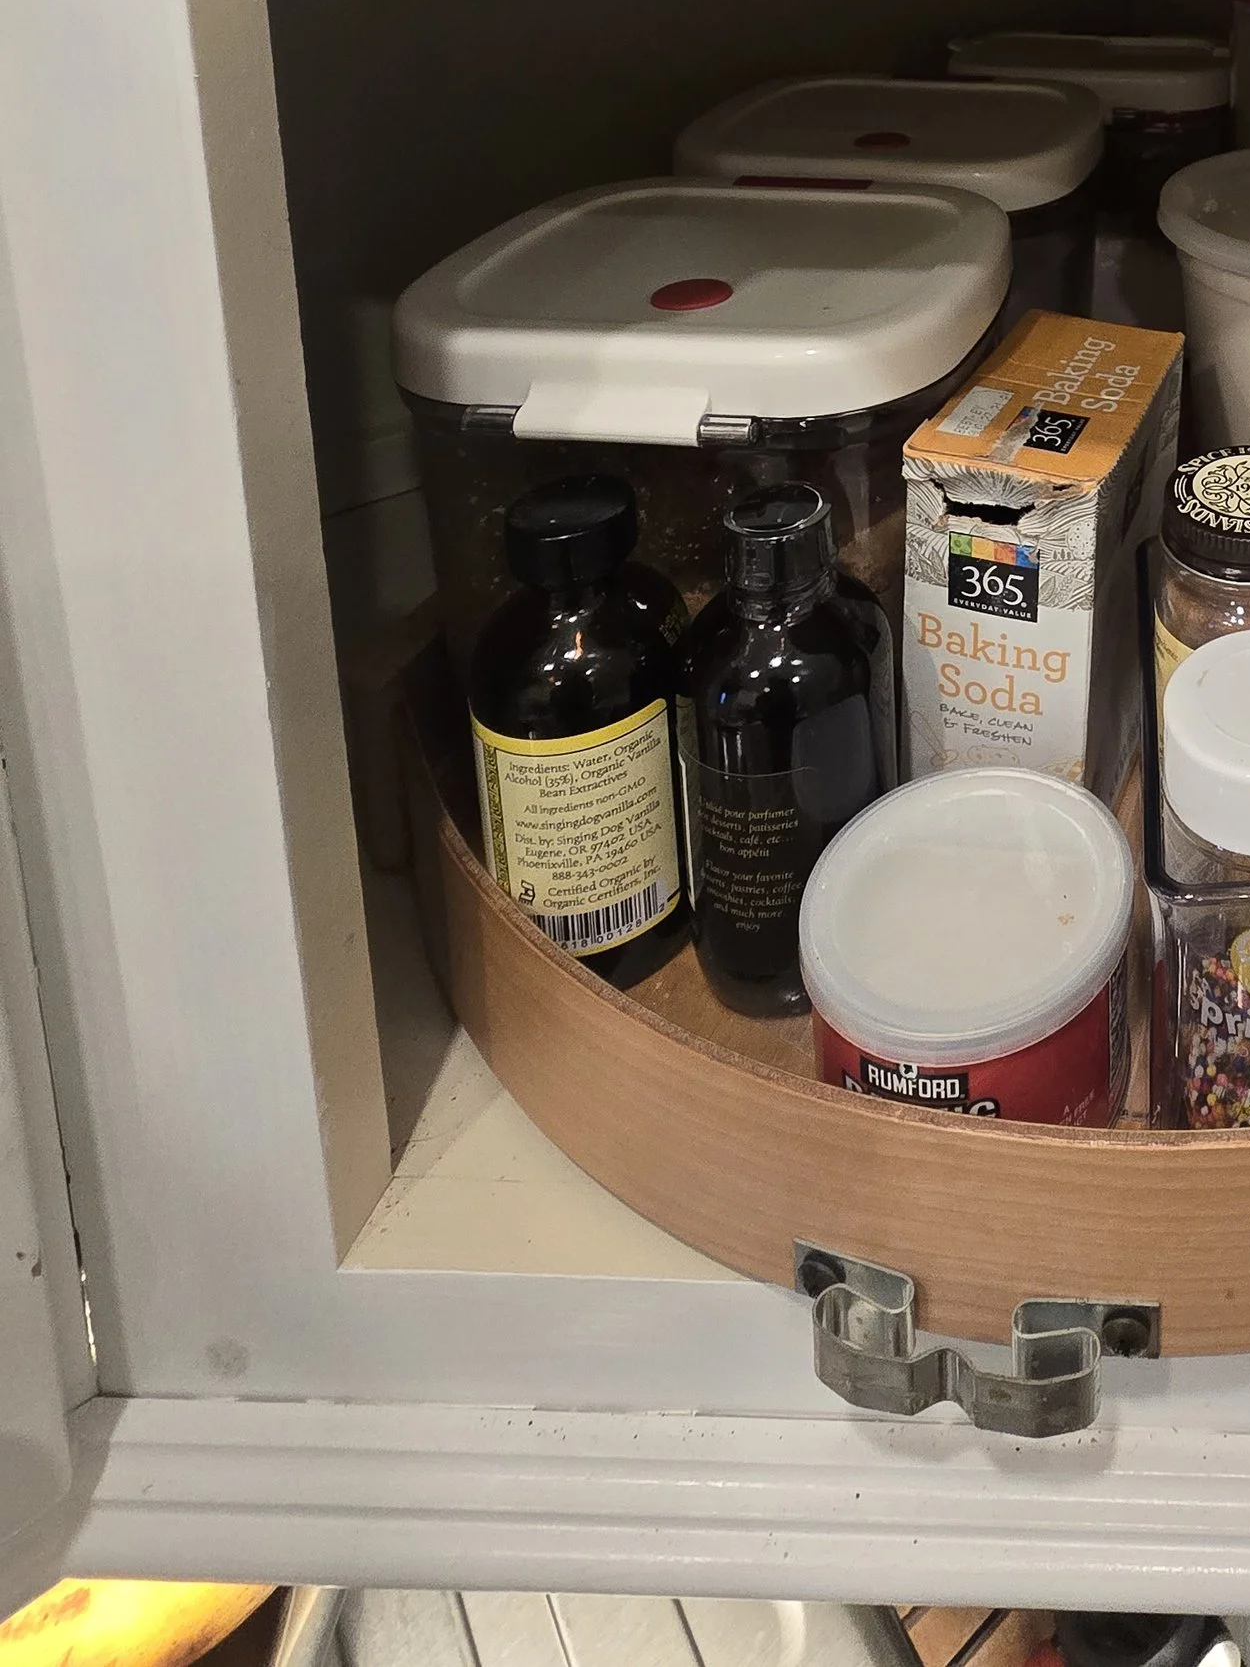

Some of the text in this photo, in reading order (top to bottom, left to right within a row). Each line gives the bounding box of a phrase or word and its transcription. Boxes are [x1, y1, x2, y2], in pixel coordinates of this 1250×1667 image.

[1033, 337, 1116, 406] Baking
[1081, 365, 1140, 413] Soda
[1033, 417, 1072, 447] 365
[1178, 448, 1234, 474] SPICE
[961, 565, 1025, 606] 365
[954, 598, 1032, 619] EVERYDAY VALUE
[918, 612, 1070, 683] Baking
[939, 663, 1043, 716] Soda
[940, 704, 1033, 731] BAKE, CLEAN
[964, 723, 1033, 746] FRESHEN
[505, 737, 661, 786] Alcohol Organic Vanilla
[626, 800, 660, 824] Vanilla
[756, 872, 794, 882] favorite
[868, 1063, 961, 1099] RUMFORD
